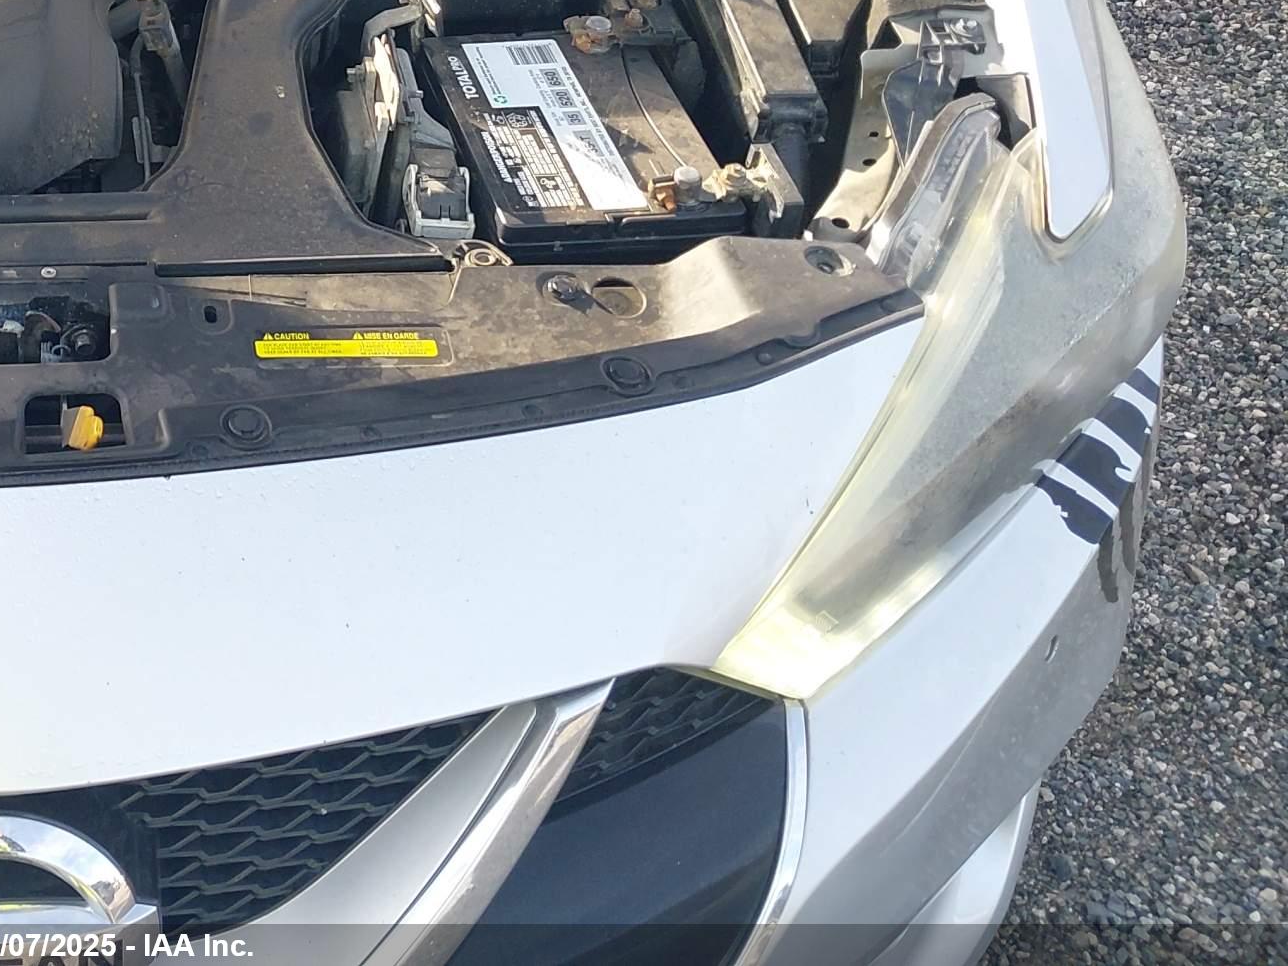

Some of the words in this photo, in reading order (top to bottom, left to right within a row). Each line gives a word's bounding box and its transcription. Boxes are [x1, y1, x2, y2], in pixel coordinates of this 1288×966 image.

[543, 71, 561, 89] 650
[555, 91, 573, 107] 520
[567, 113, 581, 124] 35
[274, 332, 310, 340] CAUTION
